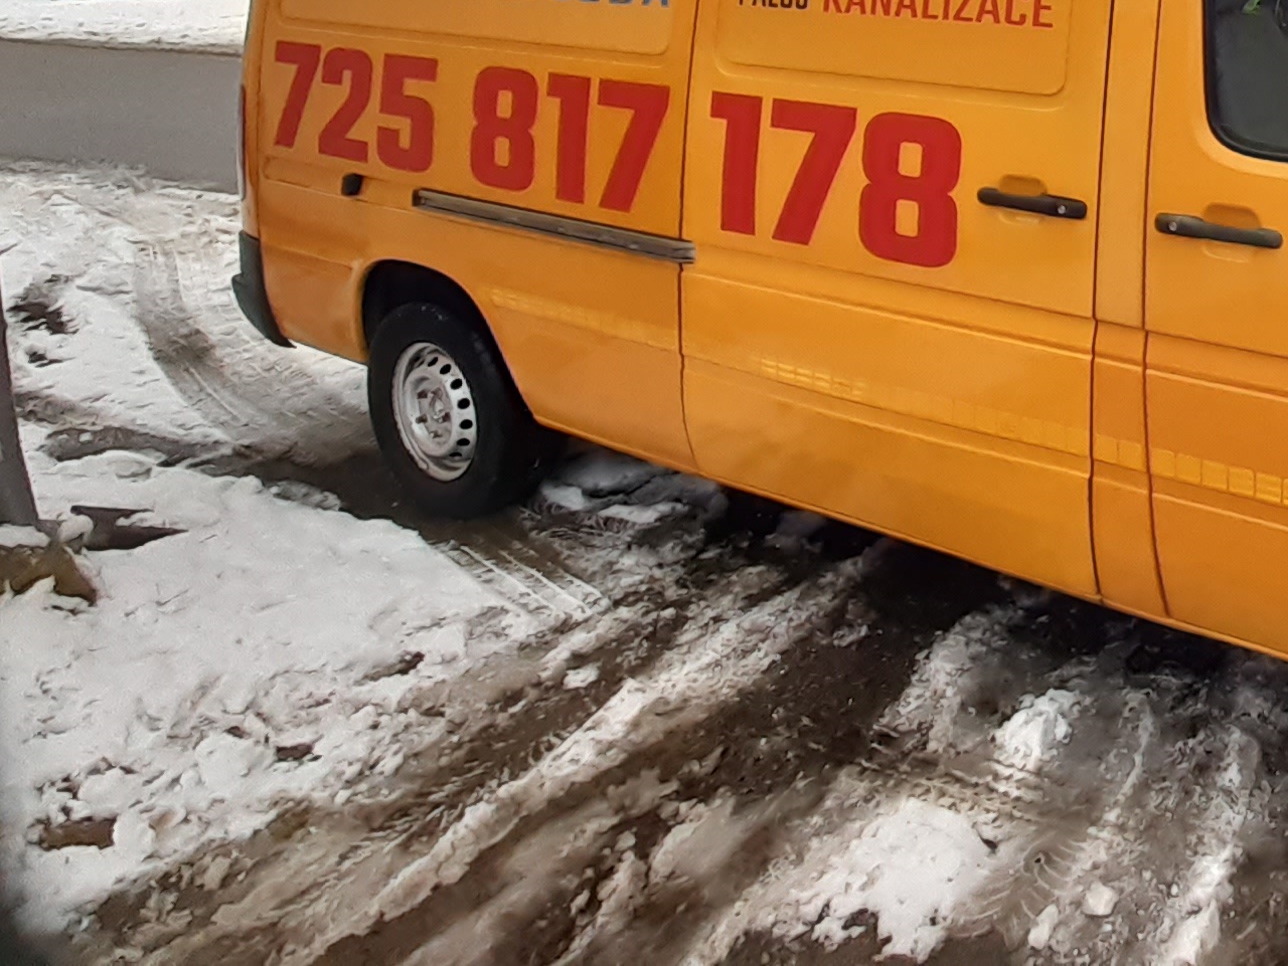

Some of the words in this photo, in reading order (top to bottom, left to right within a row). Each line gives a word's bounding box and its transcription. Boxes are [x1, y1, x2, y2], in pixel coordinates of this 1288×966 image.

[273, 40, 437, 172] 725
[470, 66, 671, 213] 817
[709, 91, 962, 268] 178
